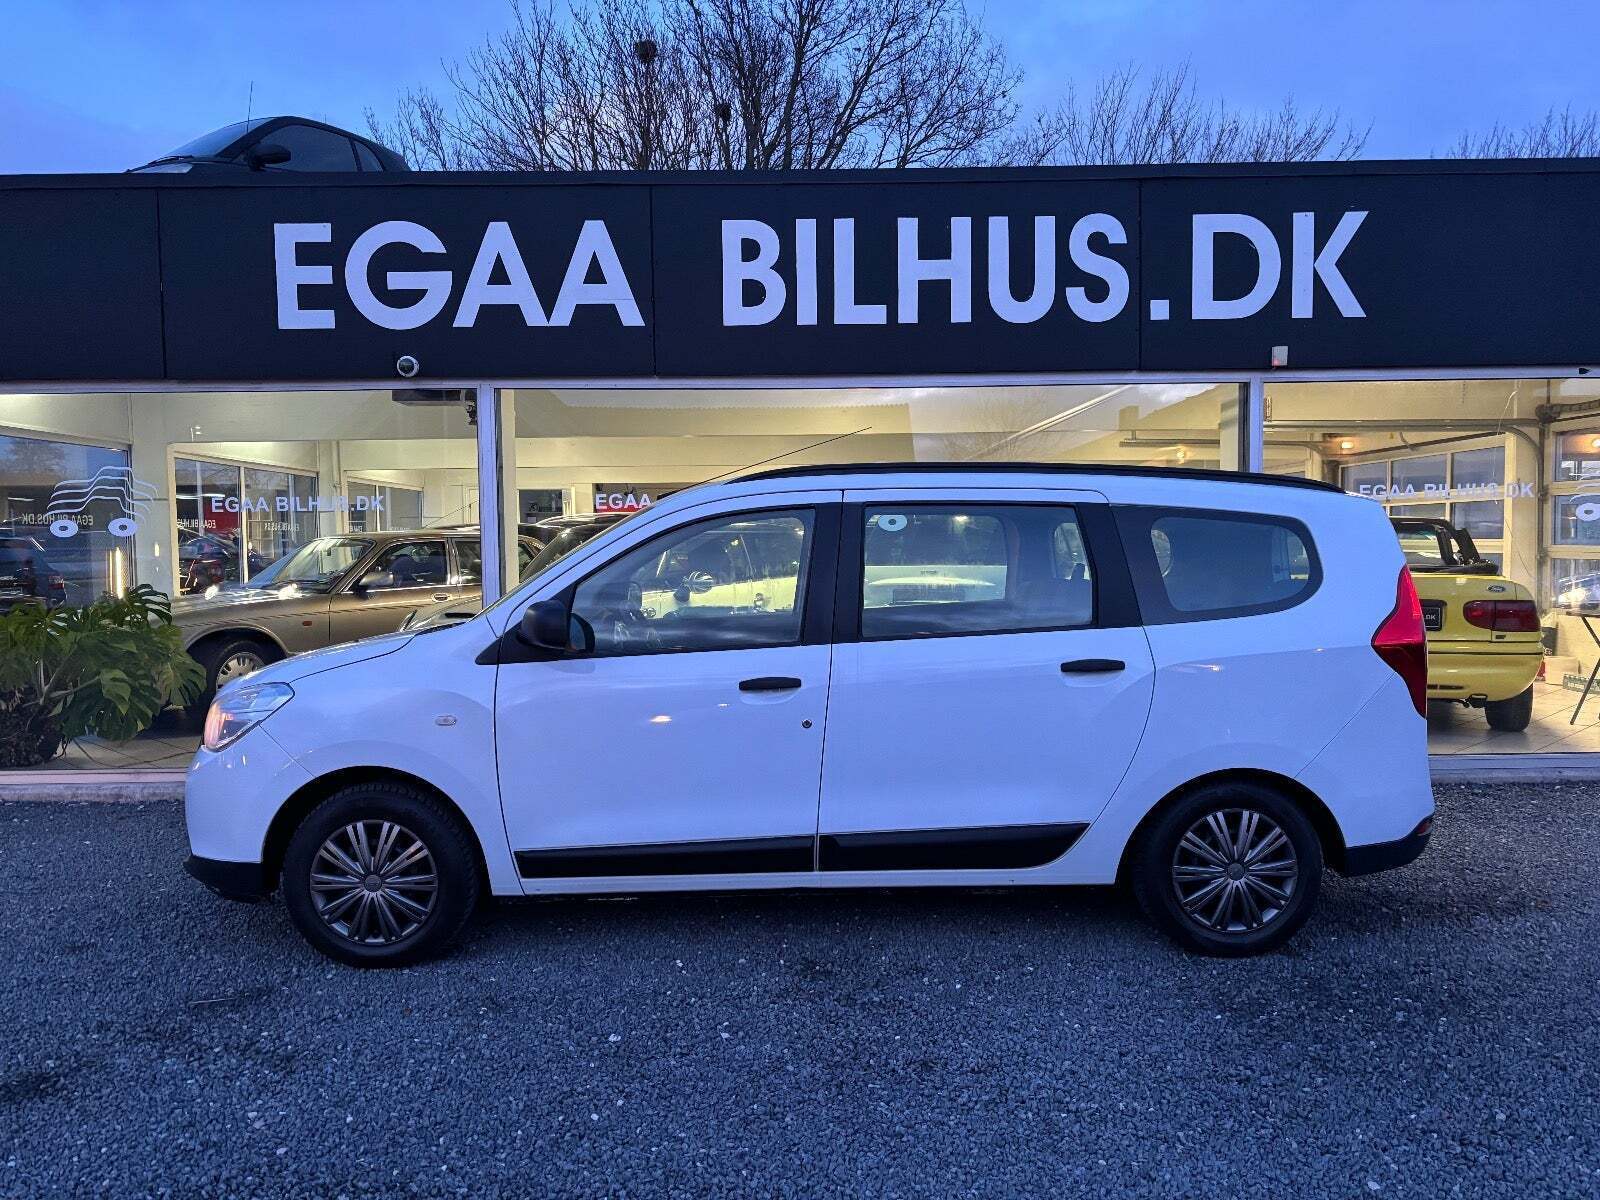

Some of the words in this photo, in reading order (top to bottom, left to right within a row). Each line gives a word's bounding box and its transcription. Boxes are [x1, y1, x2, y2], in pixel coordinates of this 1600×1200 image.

[273, 220, 646, 331] EGAA
[721, 210, 1368, 327] BILHUS.DK
[1359, 483, 1416, 499] EGAA
[211, 496, 269, 513] EGAA
[595, 493, 652, 510] EGAA
